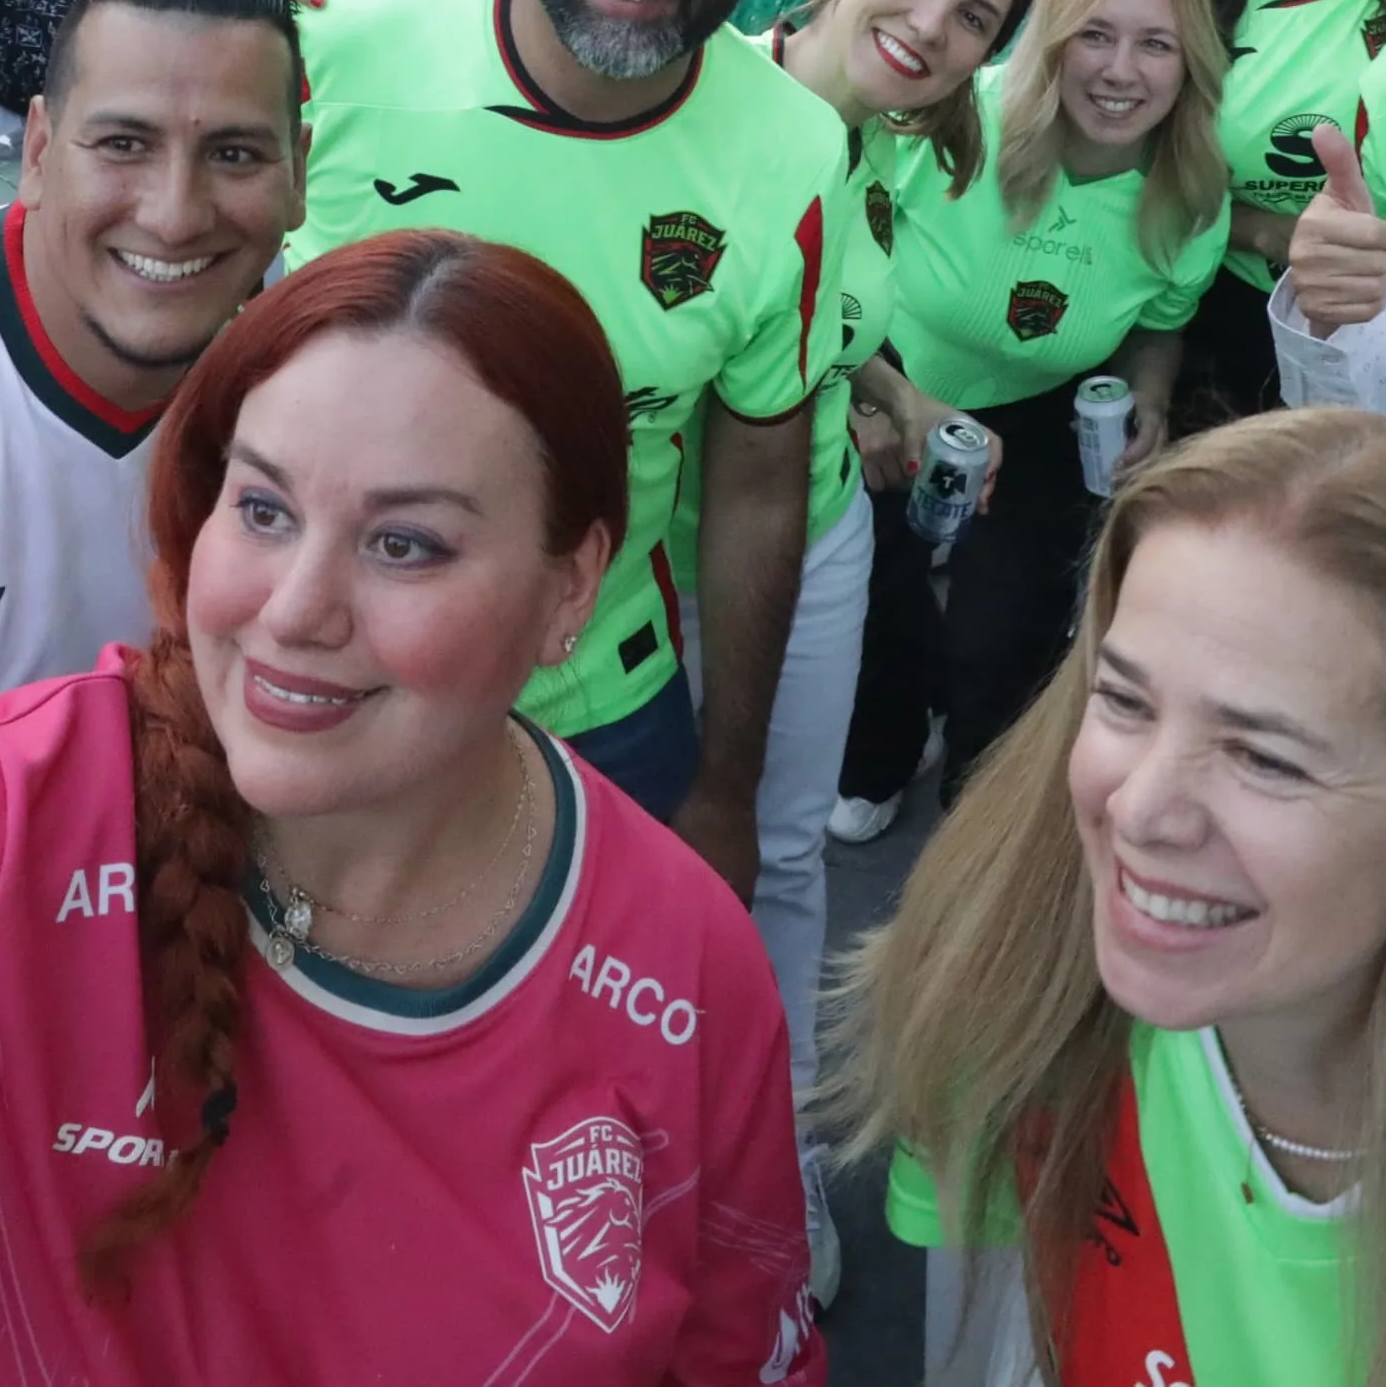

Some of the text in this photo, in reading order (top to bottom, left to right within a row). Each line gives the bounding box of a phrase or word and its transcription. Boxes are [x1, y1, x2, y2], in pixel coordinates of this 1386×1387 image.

[681, 213, 697, 225] FC
[651, 222, 717, 251] JUÁREZ
[569, 943, 698, 1046] ARCO
[590, 1124, 613, 1142] FC
[547, 1143, 644, 1191] JUÁREZ
